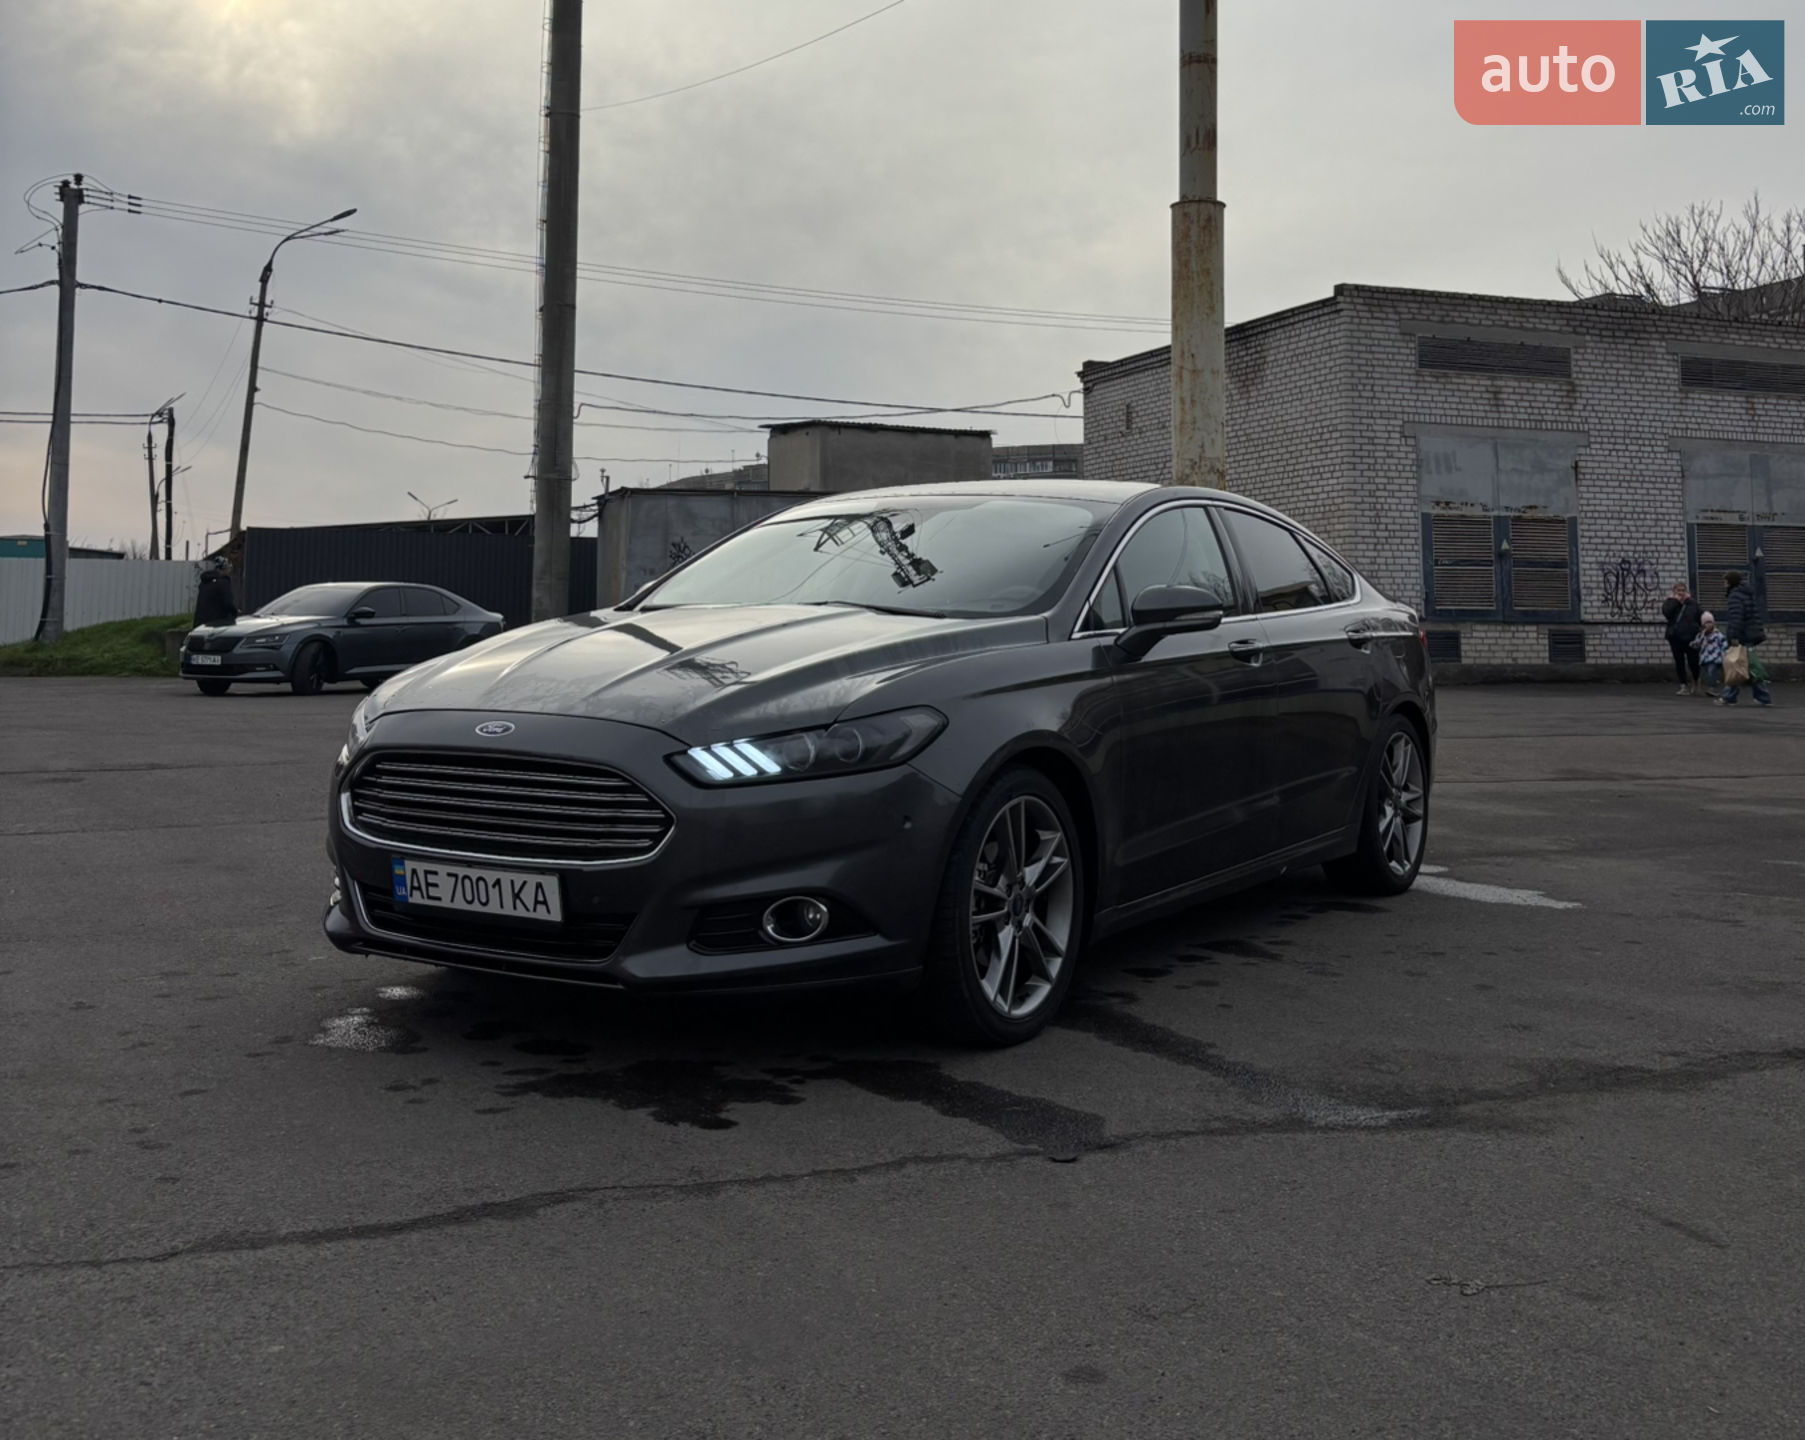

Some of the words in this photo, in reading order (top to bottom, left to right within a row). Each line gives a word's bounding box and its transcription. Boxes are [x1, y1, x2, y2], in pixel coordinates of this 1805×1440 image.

[396, 886, 407, 896] UA
[409, 868, 442, 902] AE
[446, 872, 504, 910] 7001
[510, 879, 551, 915] KA
